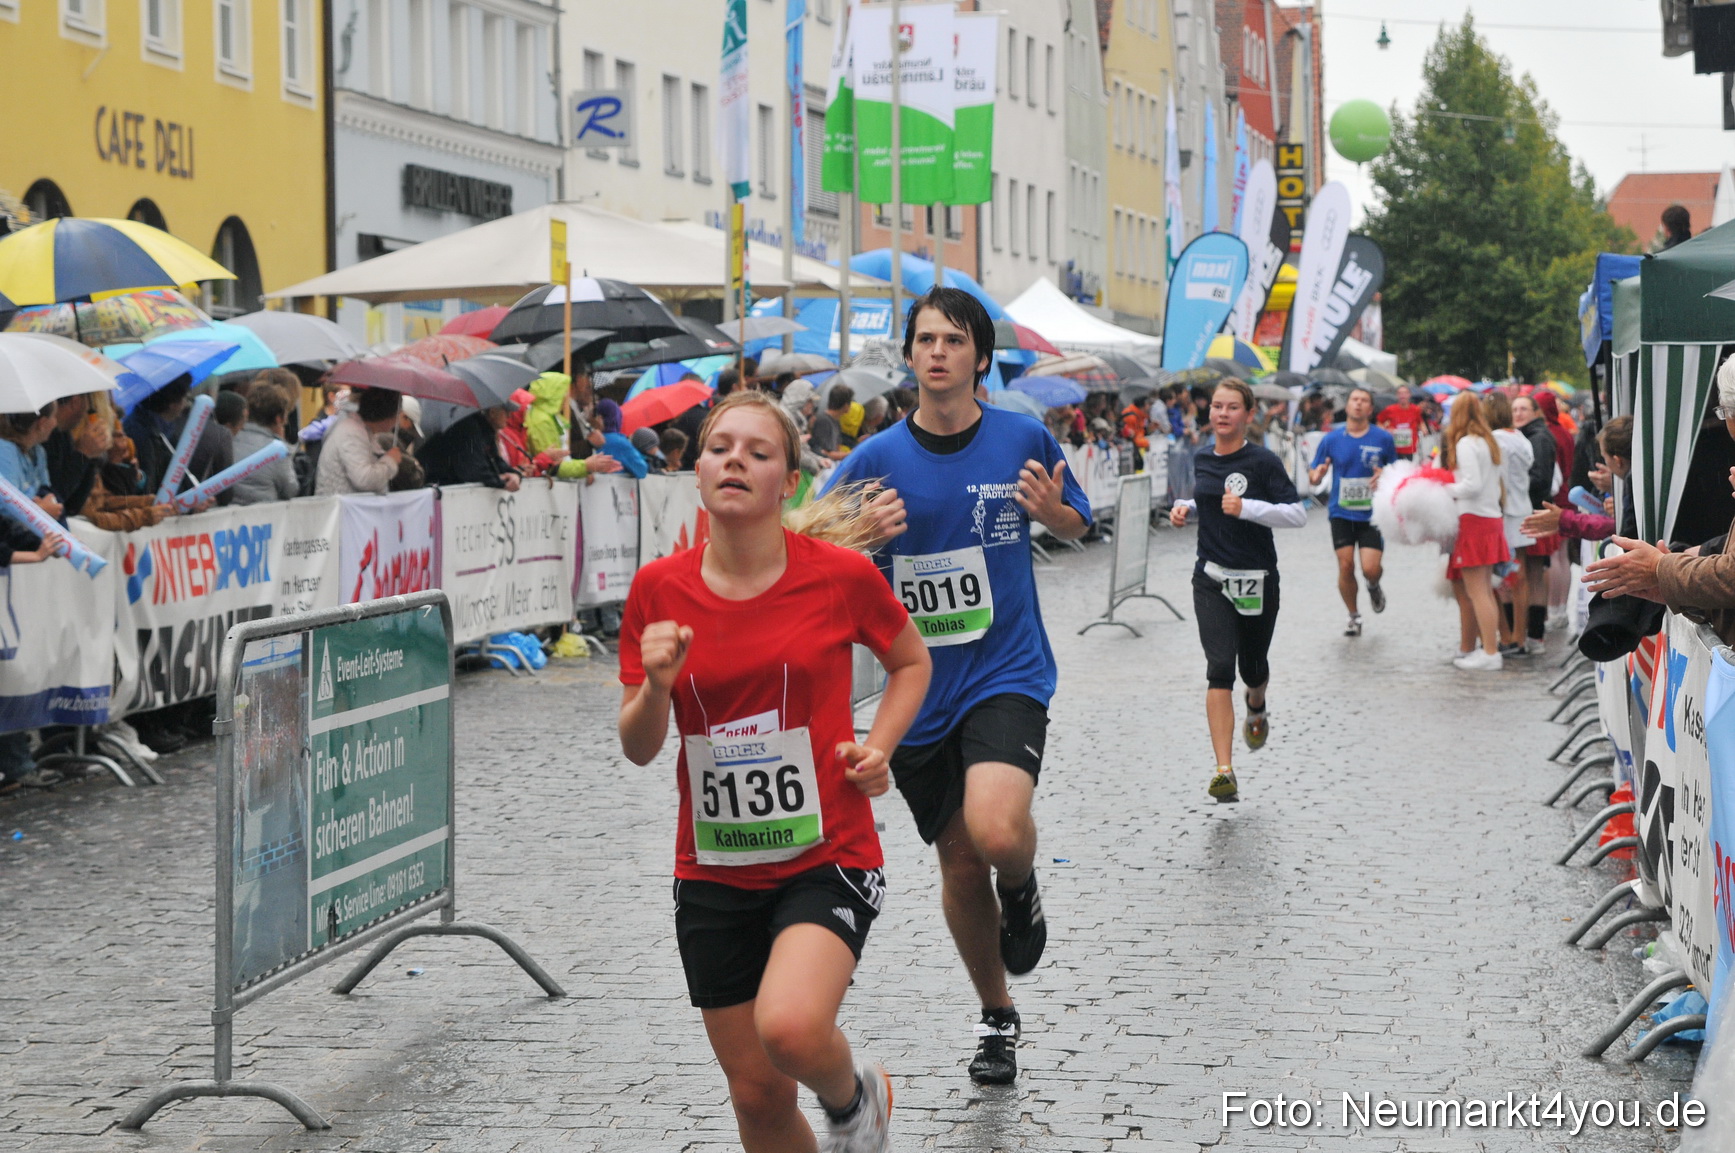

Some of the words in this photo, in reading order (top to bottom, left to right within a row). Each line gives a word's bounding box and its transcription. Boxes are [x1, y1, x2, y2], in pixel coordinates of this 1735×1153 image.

[95, 105, 146, 168] CAFE
[155, 117, 194, 180] DELI
[1191, 260, 1232, 279] maxi
[966, 484, 979, 493] 12.
[150, 523, 272, 605] INTERSPORT
[913, 558, 953, 571] BOCK
[901, 573, 981, 614] 5019
[922, 617, 966, 634] Tobias
[337, 647, 404, 682] Event-Leit-Systeme
[316, 751, 338, 794] Fun
[341, 742, 352, 785] &
[354, 732, 392, 782] Action
[394, 726, 405, 768] in
[714, 743, 767, 758] BOCK
[703, 765, 804, 818] 5136
[316, 808, 366, 859] sicheren
[368, 783, 414, 838] Bahnen!
[714, 827, 794, 847] Katharina
[344, 886, 369, 921] Service
[369, 881, 386, 908] Line:
[408, 861, 425, 890] 6352
